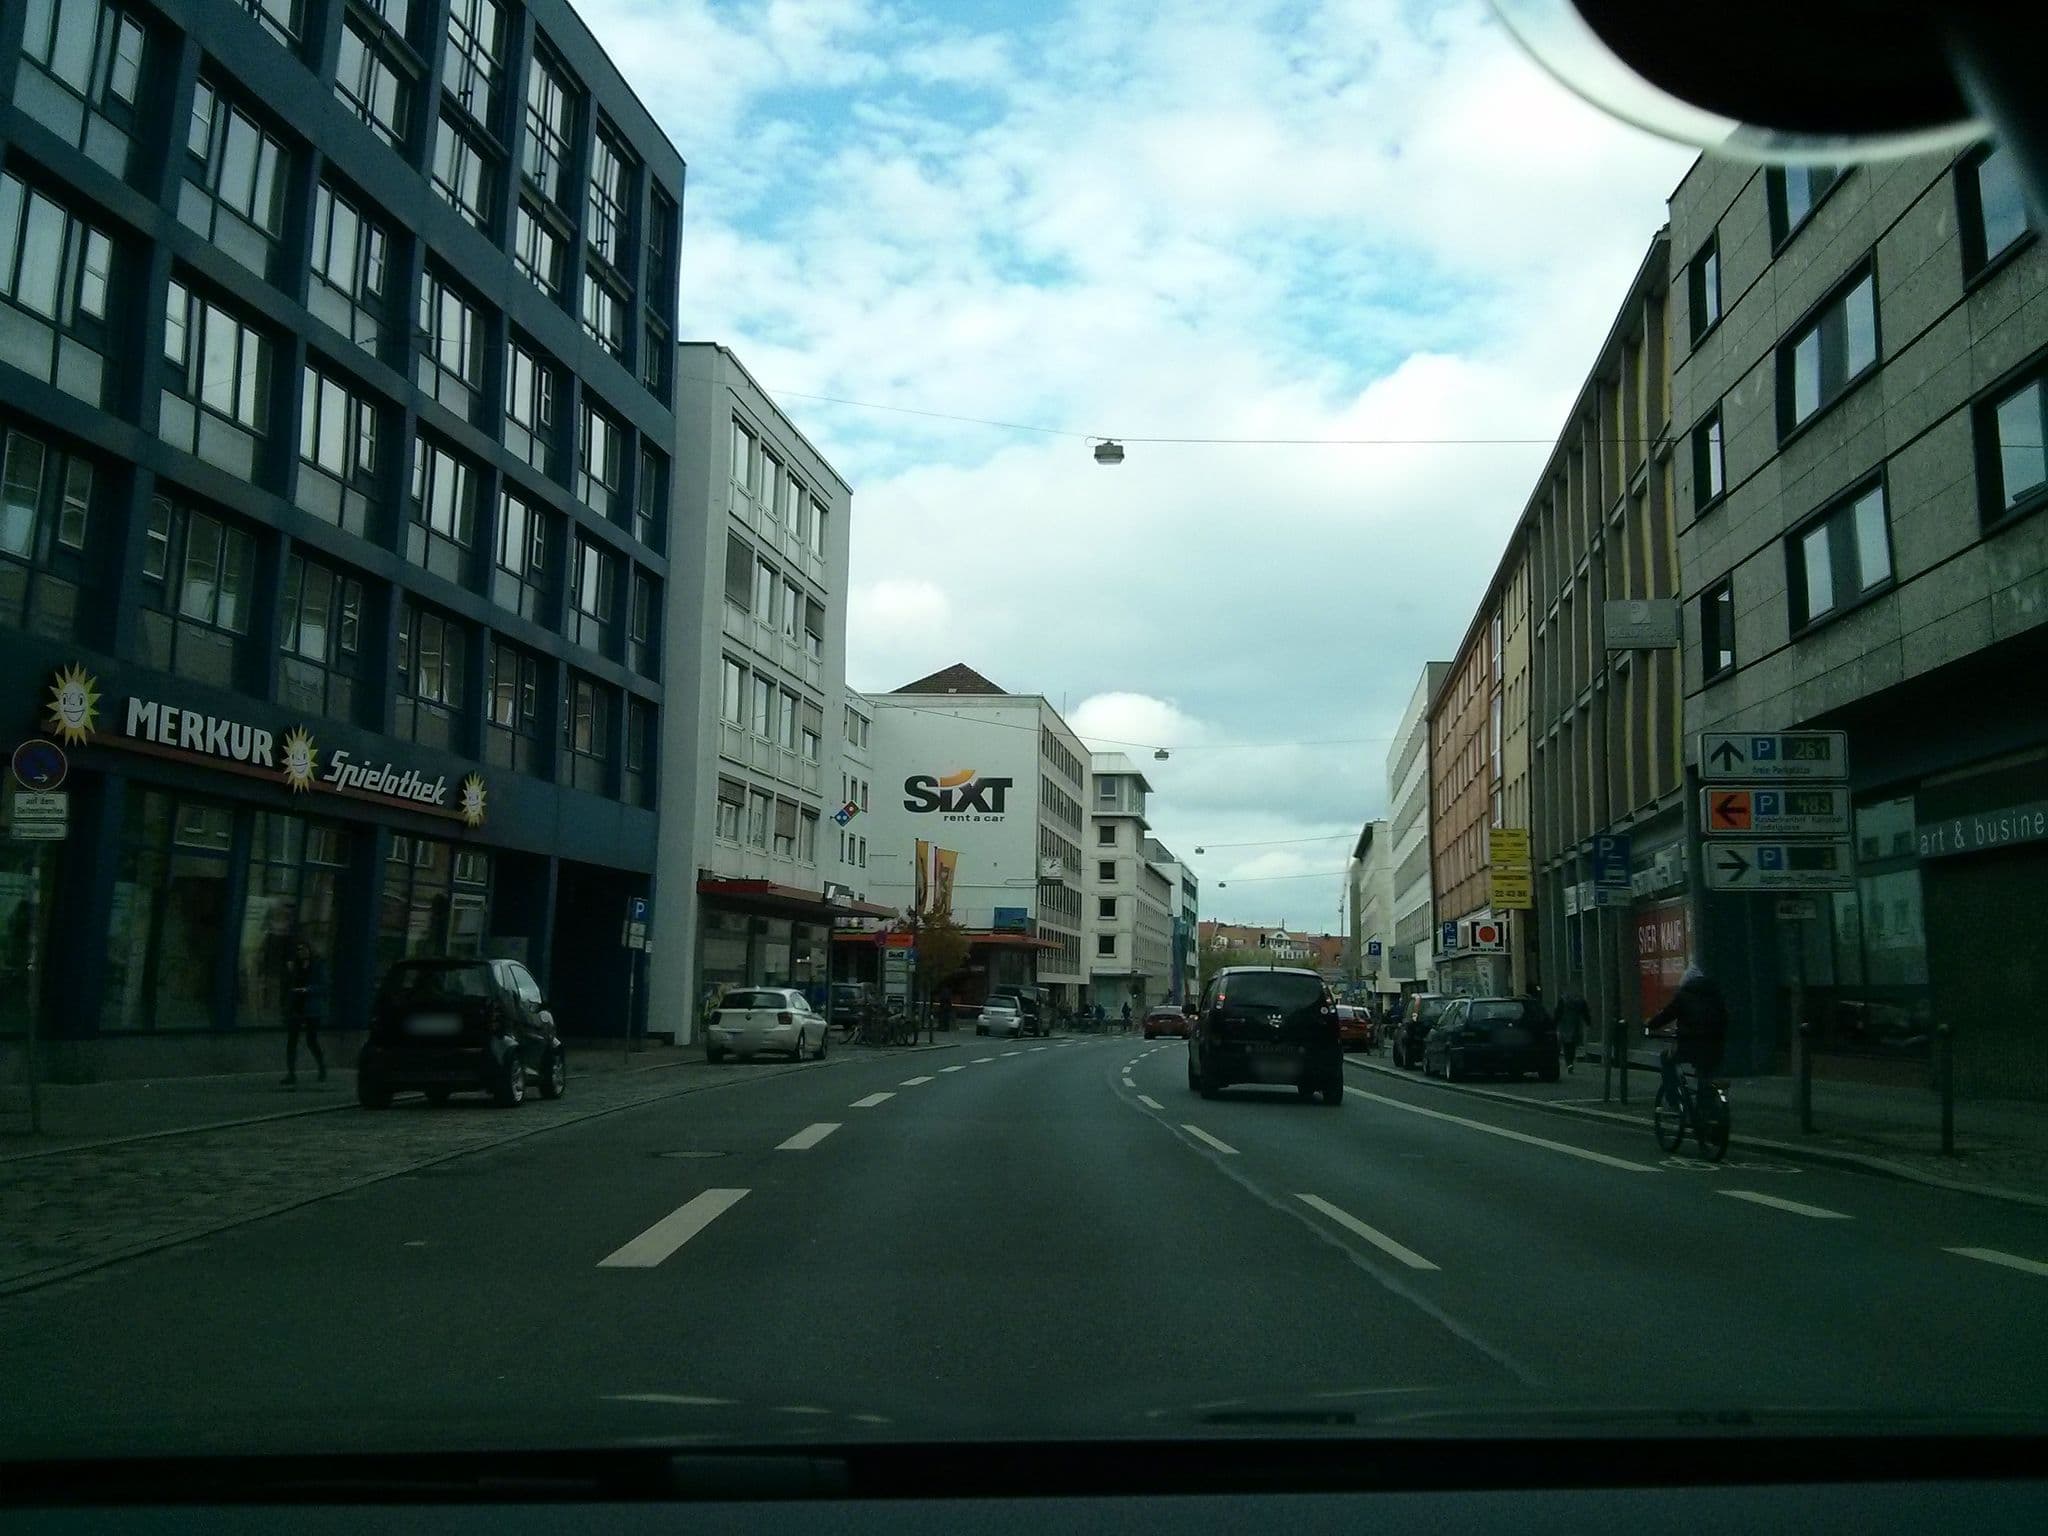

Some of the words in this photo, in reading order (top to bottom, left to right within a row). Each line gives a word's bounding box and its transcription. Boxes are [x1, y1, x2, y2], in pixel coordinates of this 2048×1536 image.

[125, 696, 273, 767] MERKUR
[322, 749, 447, 805] Spielothek
[1757, 740, 1770, 758] P
[1760, 795, 1774, 812] P
[944, 814, 971, 822] rent
[1920, 826, 1945, 856] art
[1954, 820, 1965, 849] &
[1762, 850, 1776, 867] P
[636, 902, 645, 918] P
